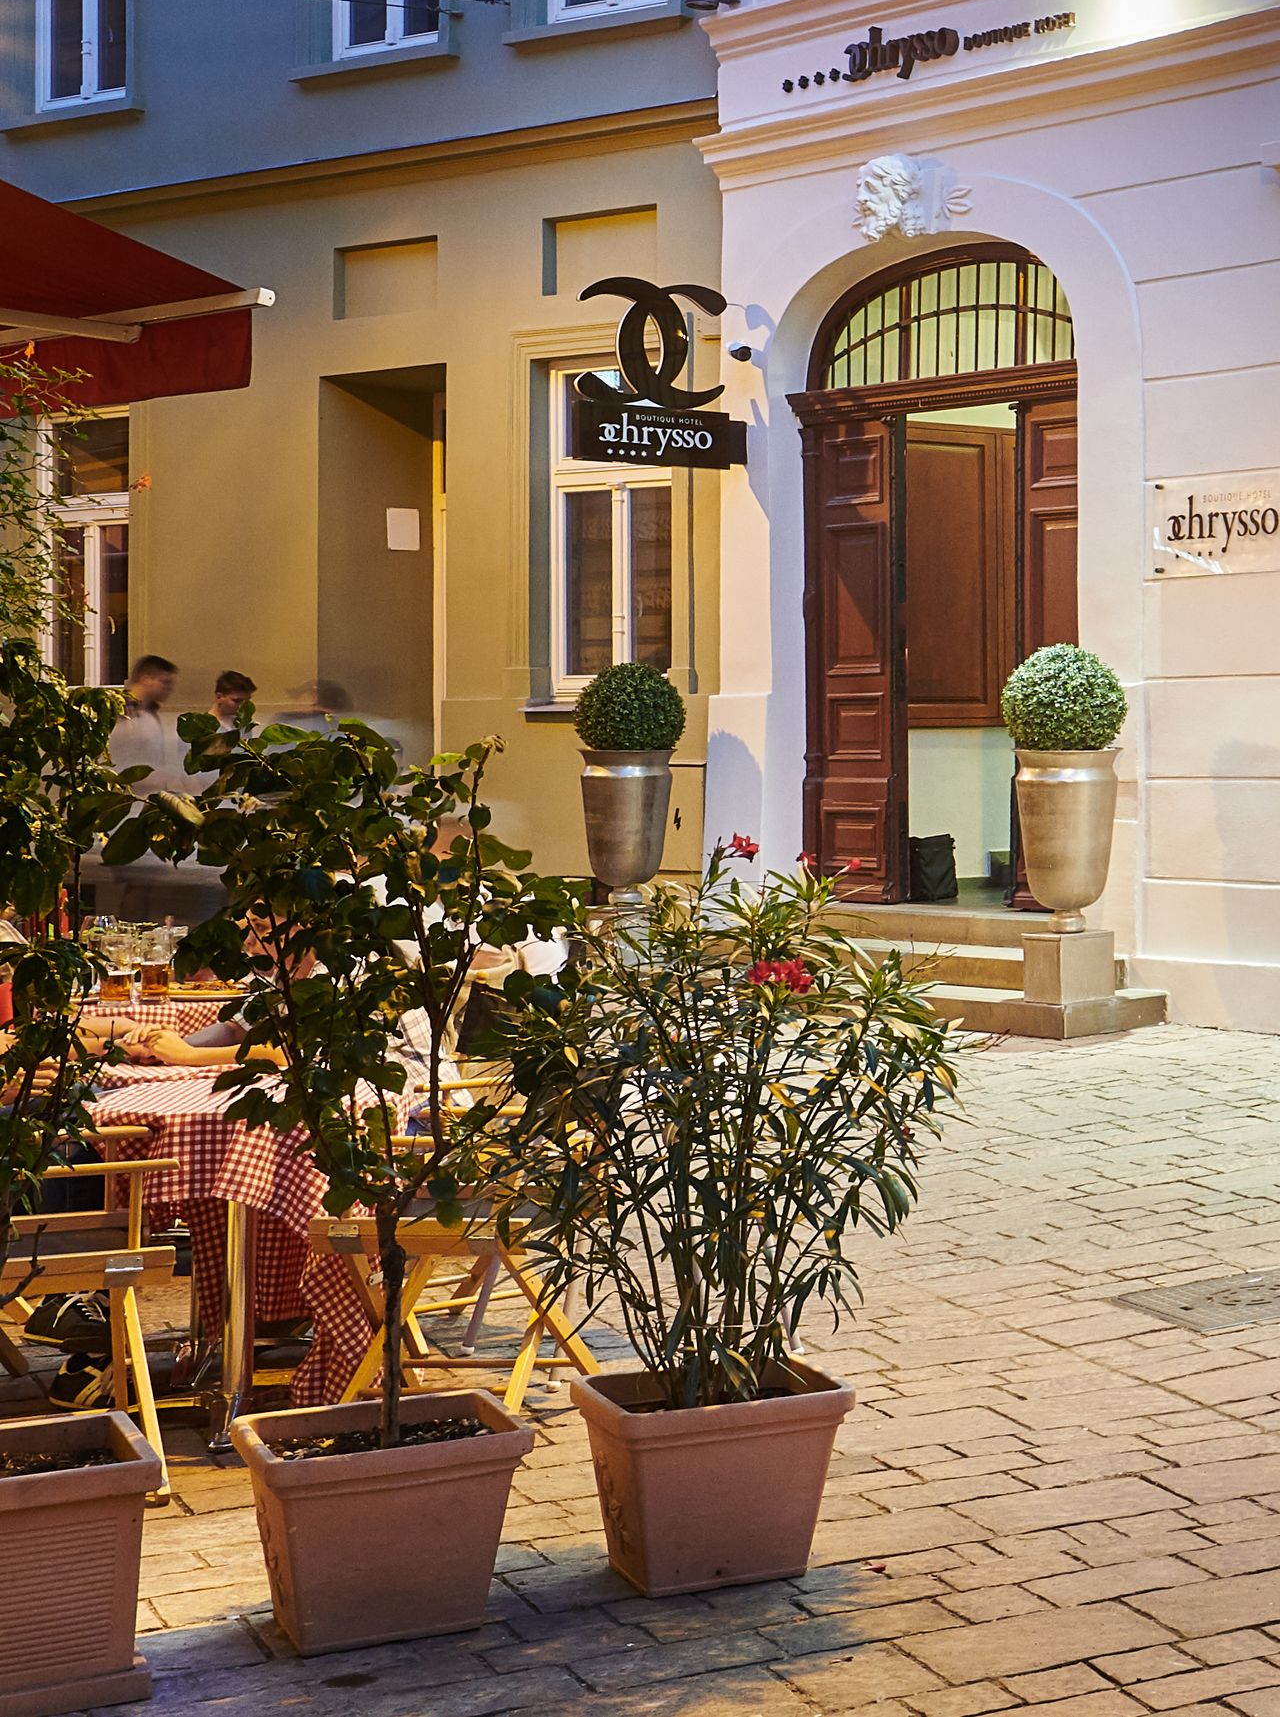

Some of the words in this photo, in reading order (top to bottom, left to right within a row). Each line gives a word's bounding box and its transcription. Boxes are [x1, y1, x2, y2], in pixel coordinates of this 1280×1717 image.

[963, 22, 1031, 51] BOUTIQUE
[1034, 11, 1076, 34] HOTEL
[635, 414, 675, 424] BOUTIQUE
[679, 417, 703, 426] HOTEL
[1202, 491, 1242, 503] BOUTIQUE
[1247, 489, 1272, 500] HOTEL
